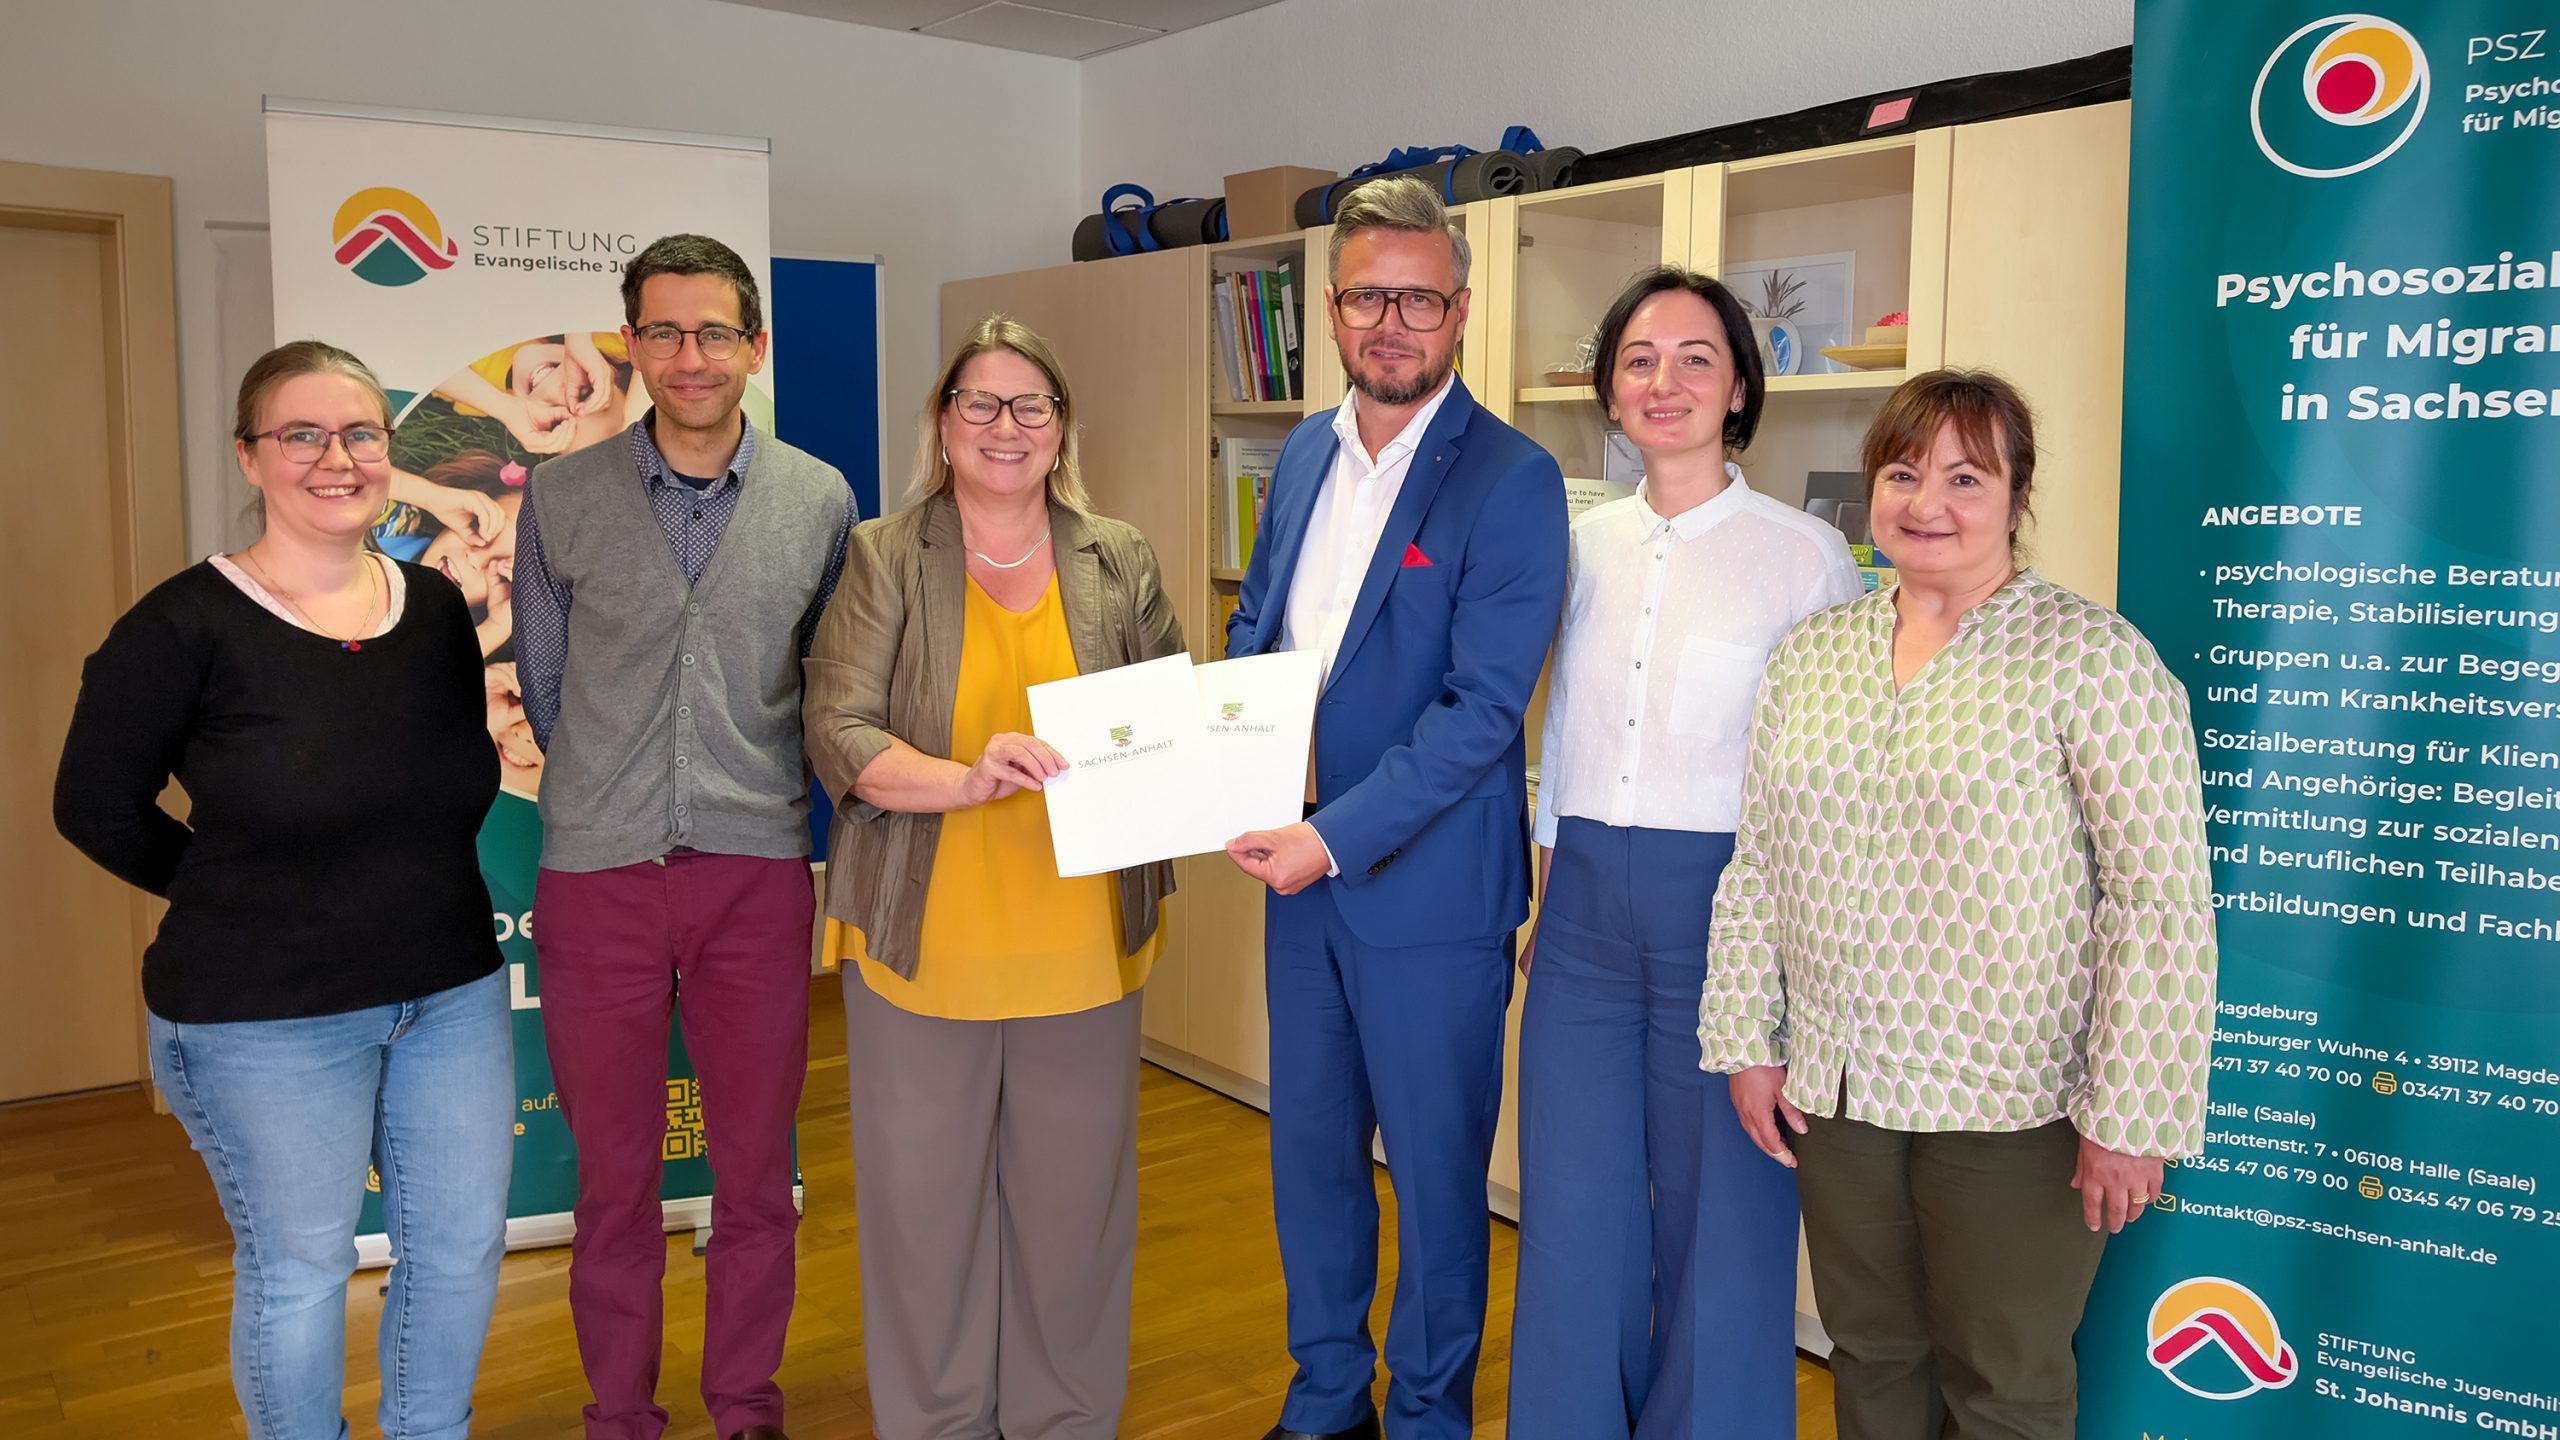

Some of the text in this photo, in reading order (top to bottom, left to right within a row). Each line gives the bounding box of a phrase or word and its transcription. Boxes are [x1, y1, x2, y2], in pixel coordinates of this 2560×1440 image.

[2467, 29, 2547, 65] PSZ
[2462, 105, 2560, 133] für Mig
[473, 225, 636, 254] STIFTUNG
[474, 253, 603, 272] Evangelische
[2216, 251, 2560, 309] Psychosozial
[2290, 322, 2367, 360] für
[2281, 383, 2328, 420] in
[1588, 489, 1605, 497] have
[2201, 505, 2362, 527] ANGEBOTE
[2215, 561, 2437, 588] psychologische
[2212, 598, 2559, 633] Therapie, Stabilisierung
[2209, 645, 2560, 684] Gruppen u.a. zur Begeg
[2207, 684, 2257, 704] und
[2267, 688, 2330, 706] zum
[1078, 739, 1174, 768] SACHSEN-ANHALT
[2203, 729, 2559, 769] Sozialberatung für Klien
[2201, 768, 2253, 788] und
[2261, 769, 2443, 804] Angehörige:
[2377, 819, 2424, 838] zur
[2433, 823, 2559, 850] sozialen
[2258, 845, 2425, 879] beruflichen
[2435, 860, 2560, 892] Teilhabe
[2407, 911, 2467, 932] und
[2317, 1038, 2389, 1062] Wuhne
[2394, 1051, 2409, 1065] 4
[2427, 1054, 2479, 1075] 39112
[2486, 1062, 2560, 1085] Magde
[2247, 1060, 2270, 1074] 37
[2275, 1062, 2301, 1078] 40
[2307, 1066, 2331, 1082] 70
[2336, 1071, 2362, 1087] 00
[2402, 1081, 2460, 1102] 03471
[2466, 1089, 2492, 1106] 37
[2497, 1095, 2526, 1111] 40
[2532, 1098, 2559, 1116] 70
[2254, 1105, 2316, 1130] (Saale)
[2204, 1131, 2536, 1196] arlottenstr. 7 06108 Halle (Saale)
[2183, 1156, 2230, 1172] 0345
[2235, 1161, 2259, 1176] 47
[2263, 1164, 2289, 1180] 06
[2294, 1168, 2317, 1185] 79
[2322, 1173, 2349, 1191] 00
[2388, 1186, 2439, 1207] 0345
[2445, 1195, 2471, 1212] 47
[2477, 1200, 2504, 1217] 06
[2510, 1204, 2536, 1222] 79
[2181, 1199, 2498, 1265] kontakt@psz-sachsen-anhalt.de
[2318, 1333, 2416, 1364] STIFTUNG
[2317, 1351, 2447, 1389] Evangelische
[2315, 1378, 2558, 1440] St. Johannis GmbH
